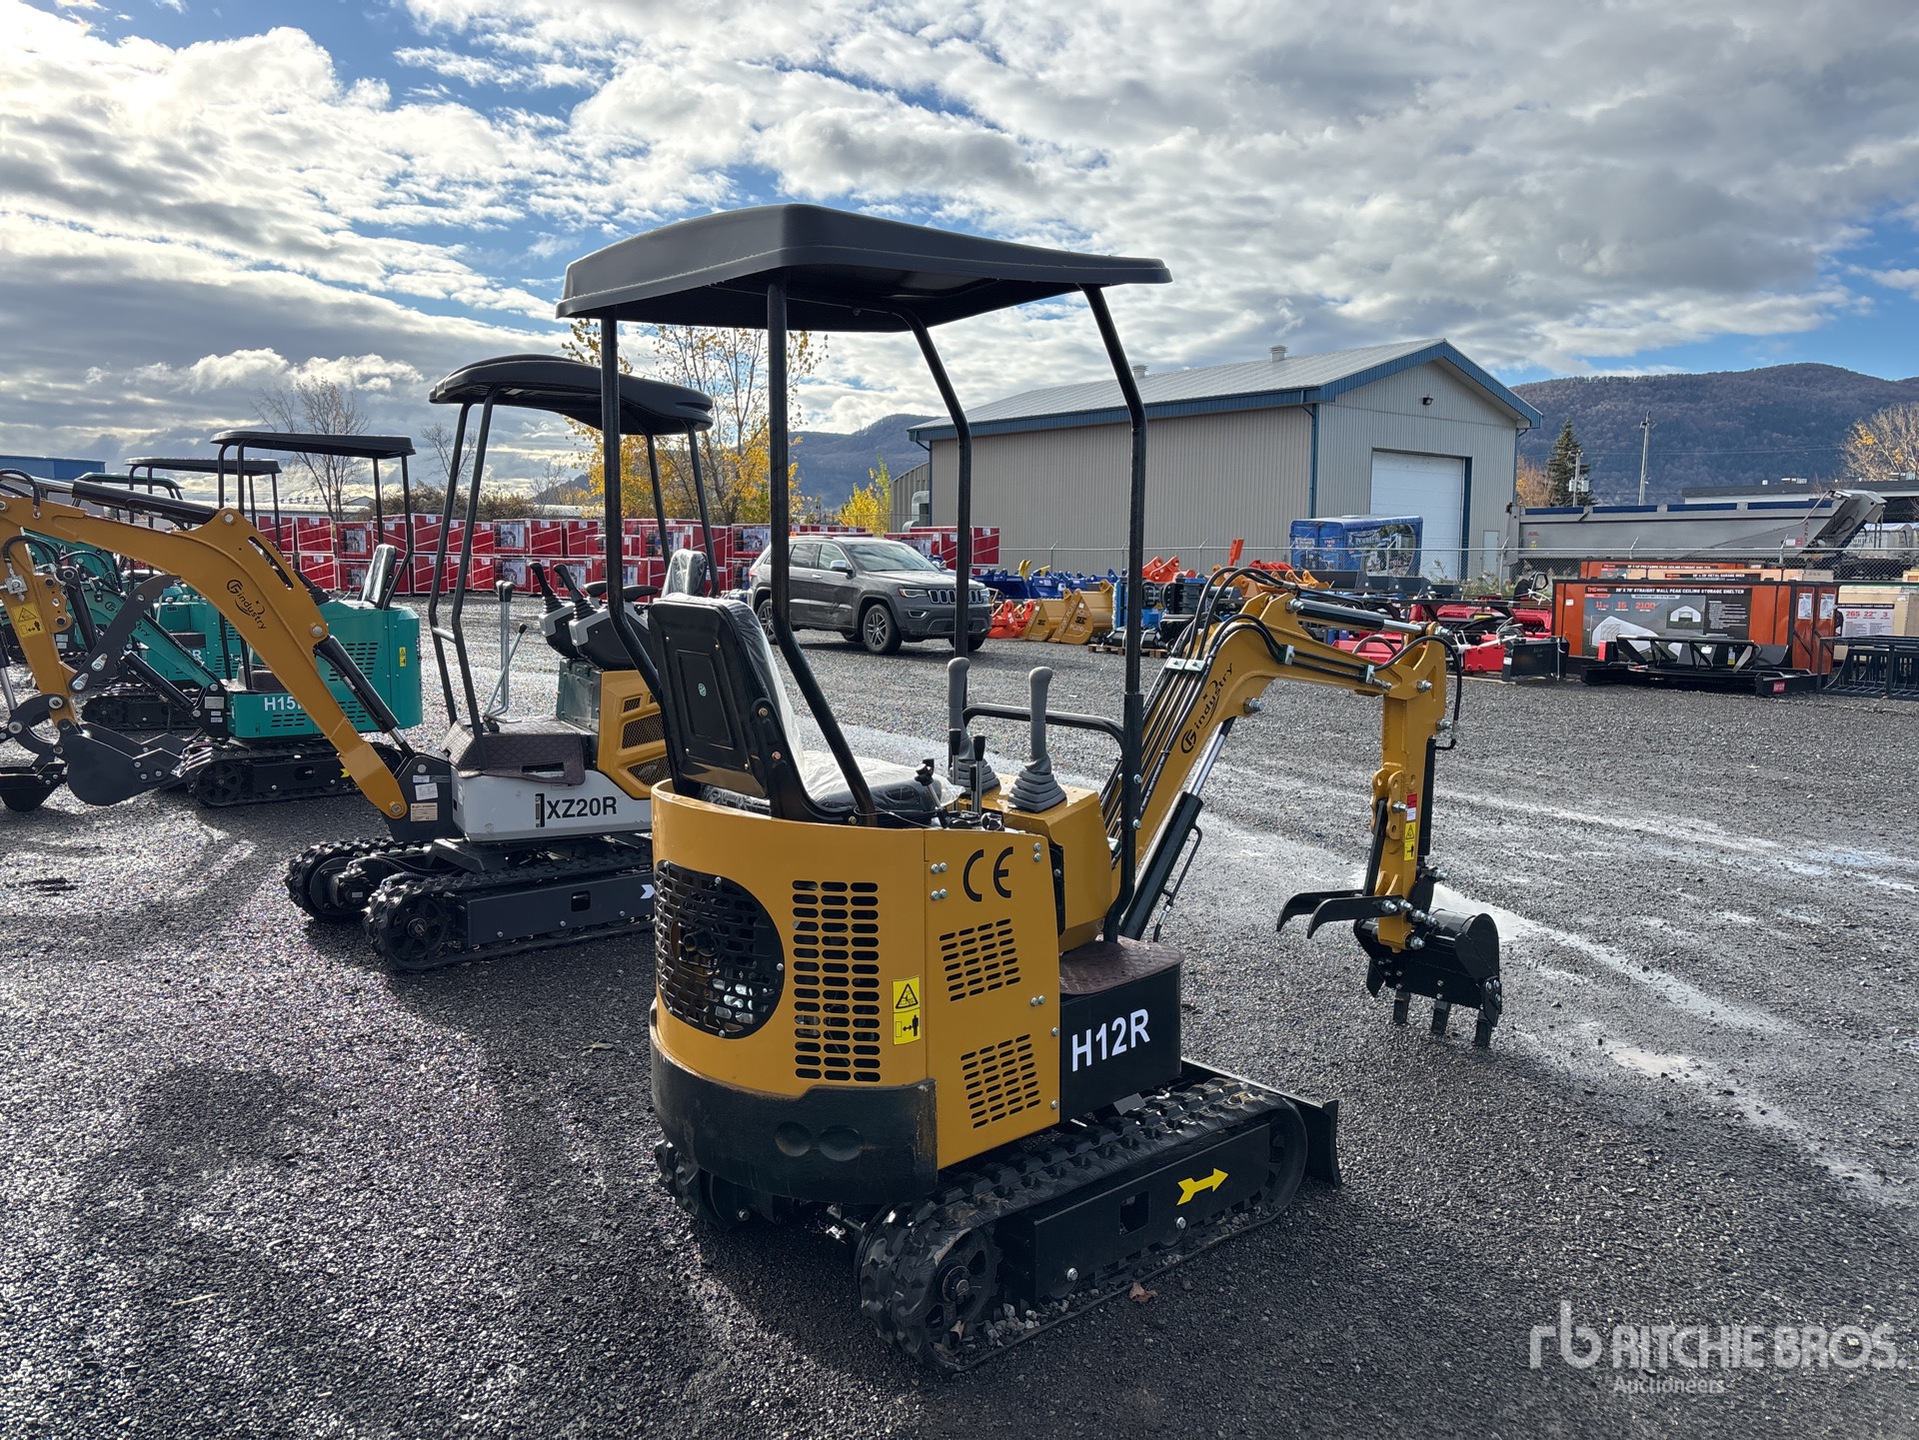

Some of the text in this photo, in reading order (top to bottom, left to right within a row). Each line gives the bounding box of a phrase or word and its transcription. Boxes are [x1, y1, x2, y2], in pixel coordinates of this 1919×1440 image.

[546, 796, 617, 820] XZ20R
[963, 846, 1014, 902] CE
[1071, 1008, 1151, 1072] H12R
